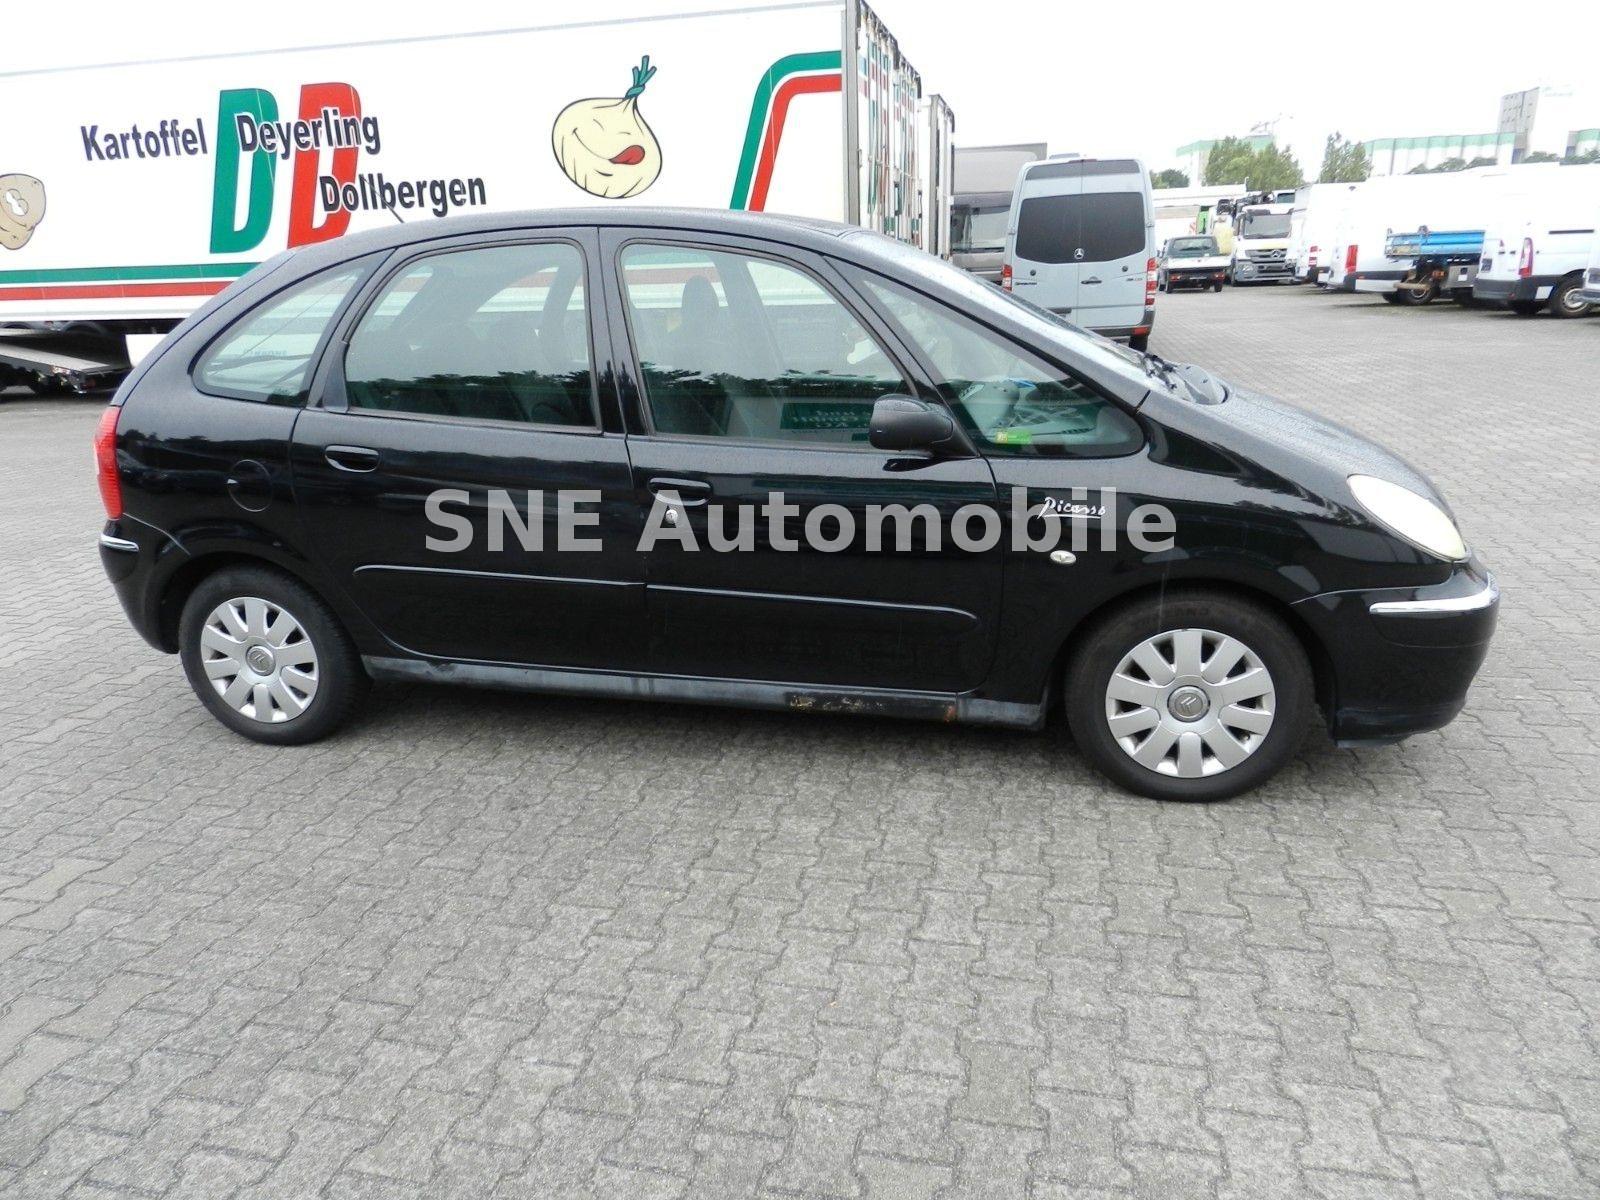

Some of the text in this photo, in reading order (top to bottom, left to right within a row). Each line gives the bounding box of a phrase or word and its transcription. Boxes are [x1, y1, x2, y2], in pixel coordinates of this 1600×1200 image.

[82, 111, 380, 161] Kartoffel Deyerling
[320, 174, 486, 217] Dollbergen
[1037, 497, 1107, 520] Picasso
